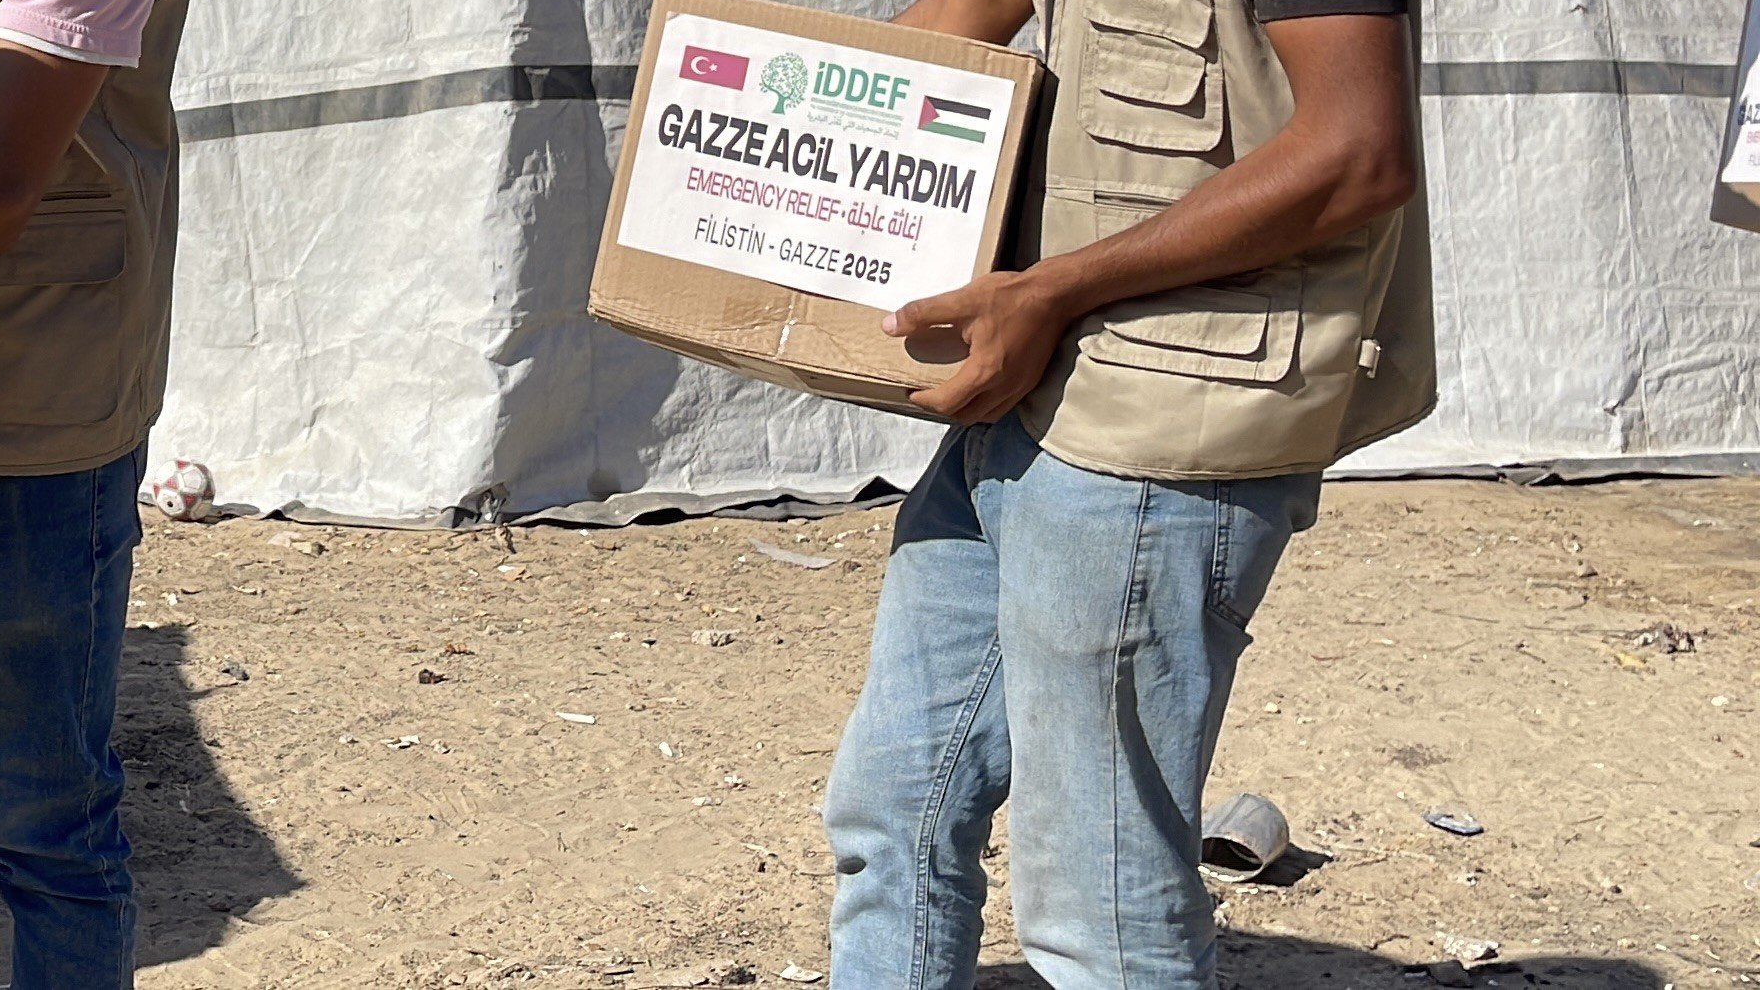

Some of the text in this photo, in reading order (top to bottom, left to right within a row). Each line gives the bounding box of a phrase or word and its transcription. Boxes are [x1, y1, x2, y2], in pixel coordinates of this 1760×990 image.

[658, 103, 768, 166] GAZZE
[849, 143, 977, 214] YARDIM
[686, 166, 787, 211] EMERGENCY
[787, 189, 841, 223] RELIEF
[847, 201, 923, 251] إغاثة عاجلة
[694, 214, 766, 255] FİLİSTİN
[779, 238, 841, 273] GAZZE
[841, 252, 893, 285] 2025
